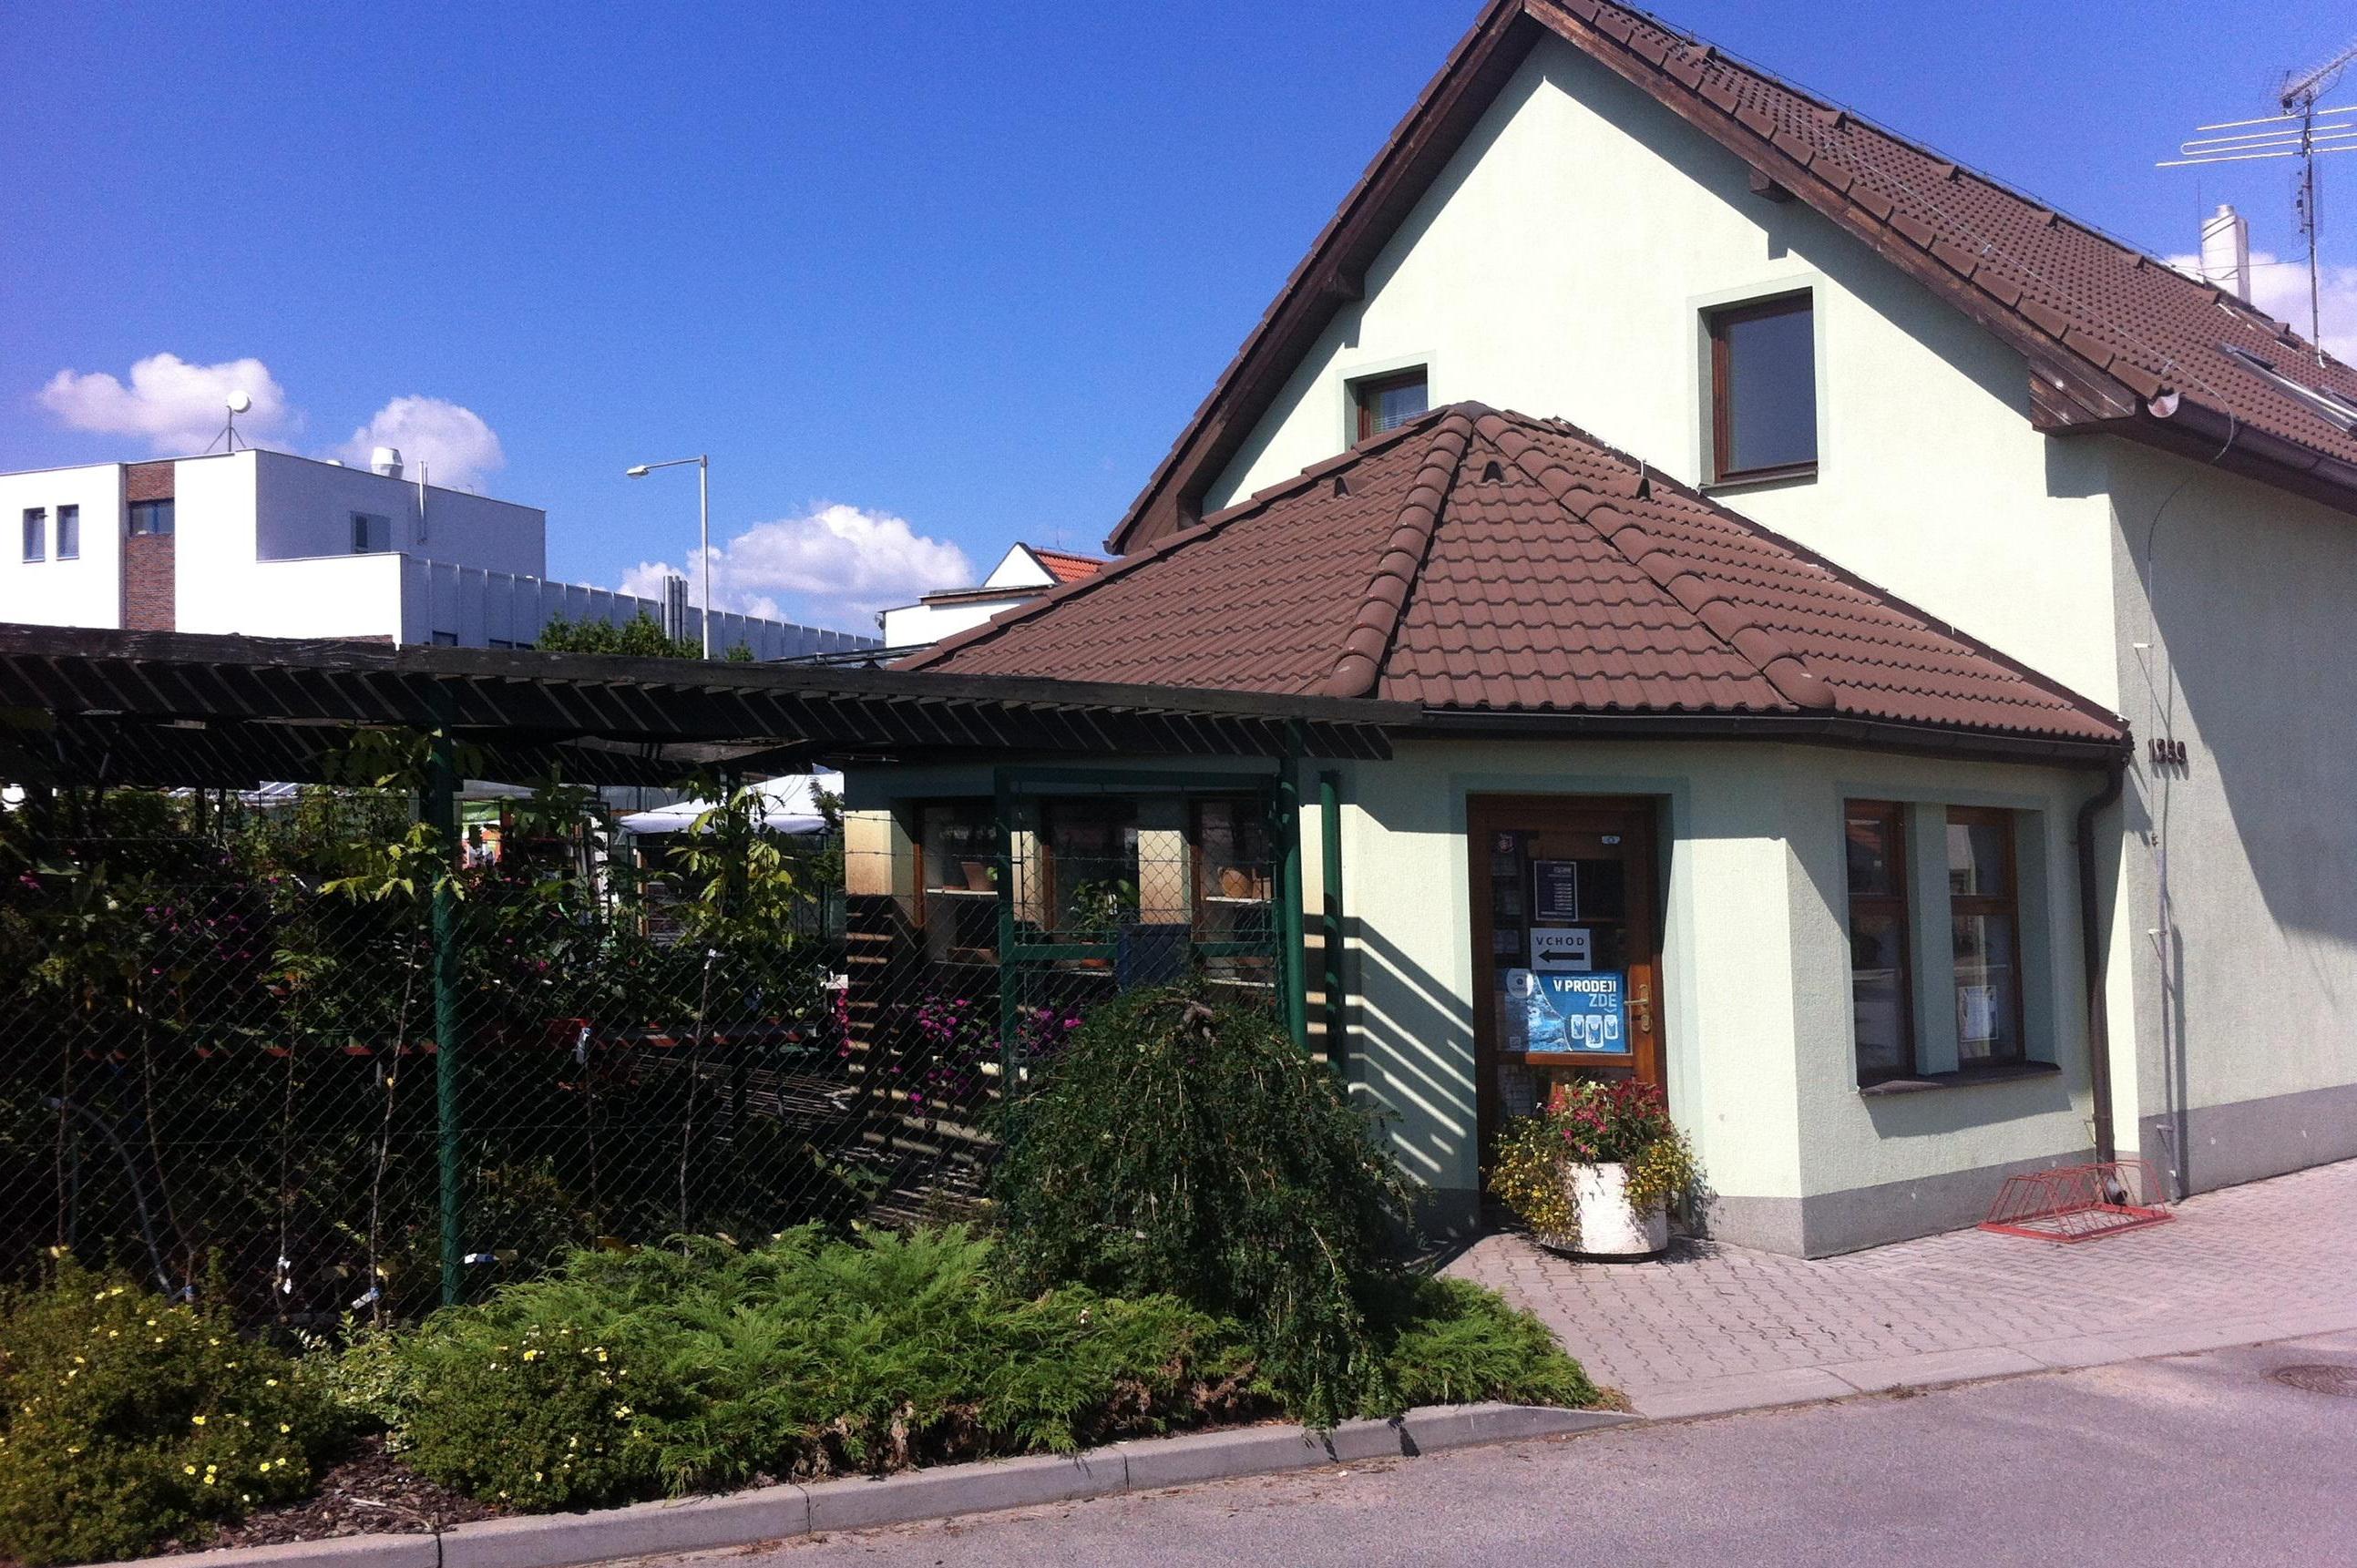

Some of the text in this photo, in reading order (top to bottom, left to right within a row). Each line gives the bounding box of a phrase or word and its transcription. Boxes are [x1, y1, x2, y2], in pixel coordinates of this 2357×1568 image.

[1536, 937, 1585, 947] VCHOD
[1553, 979, 1617, 992] V PRODEJI
[1588, 993, 1617, 1008] ZDE
